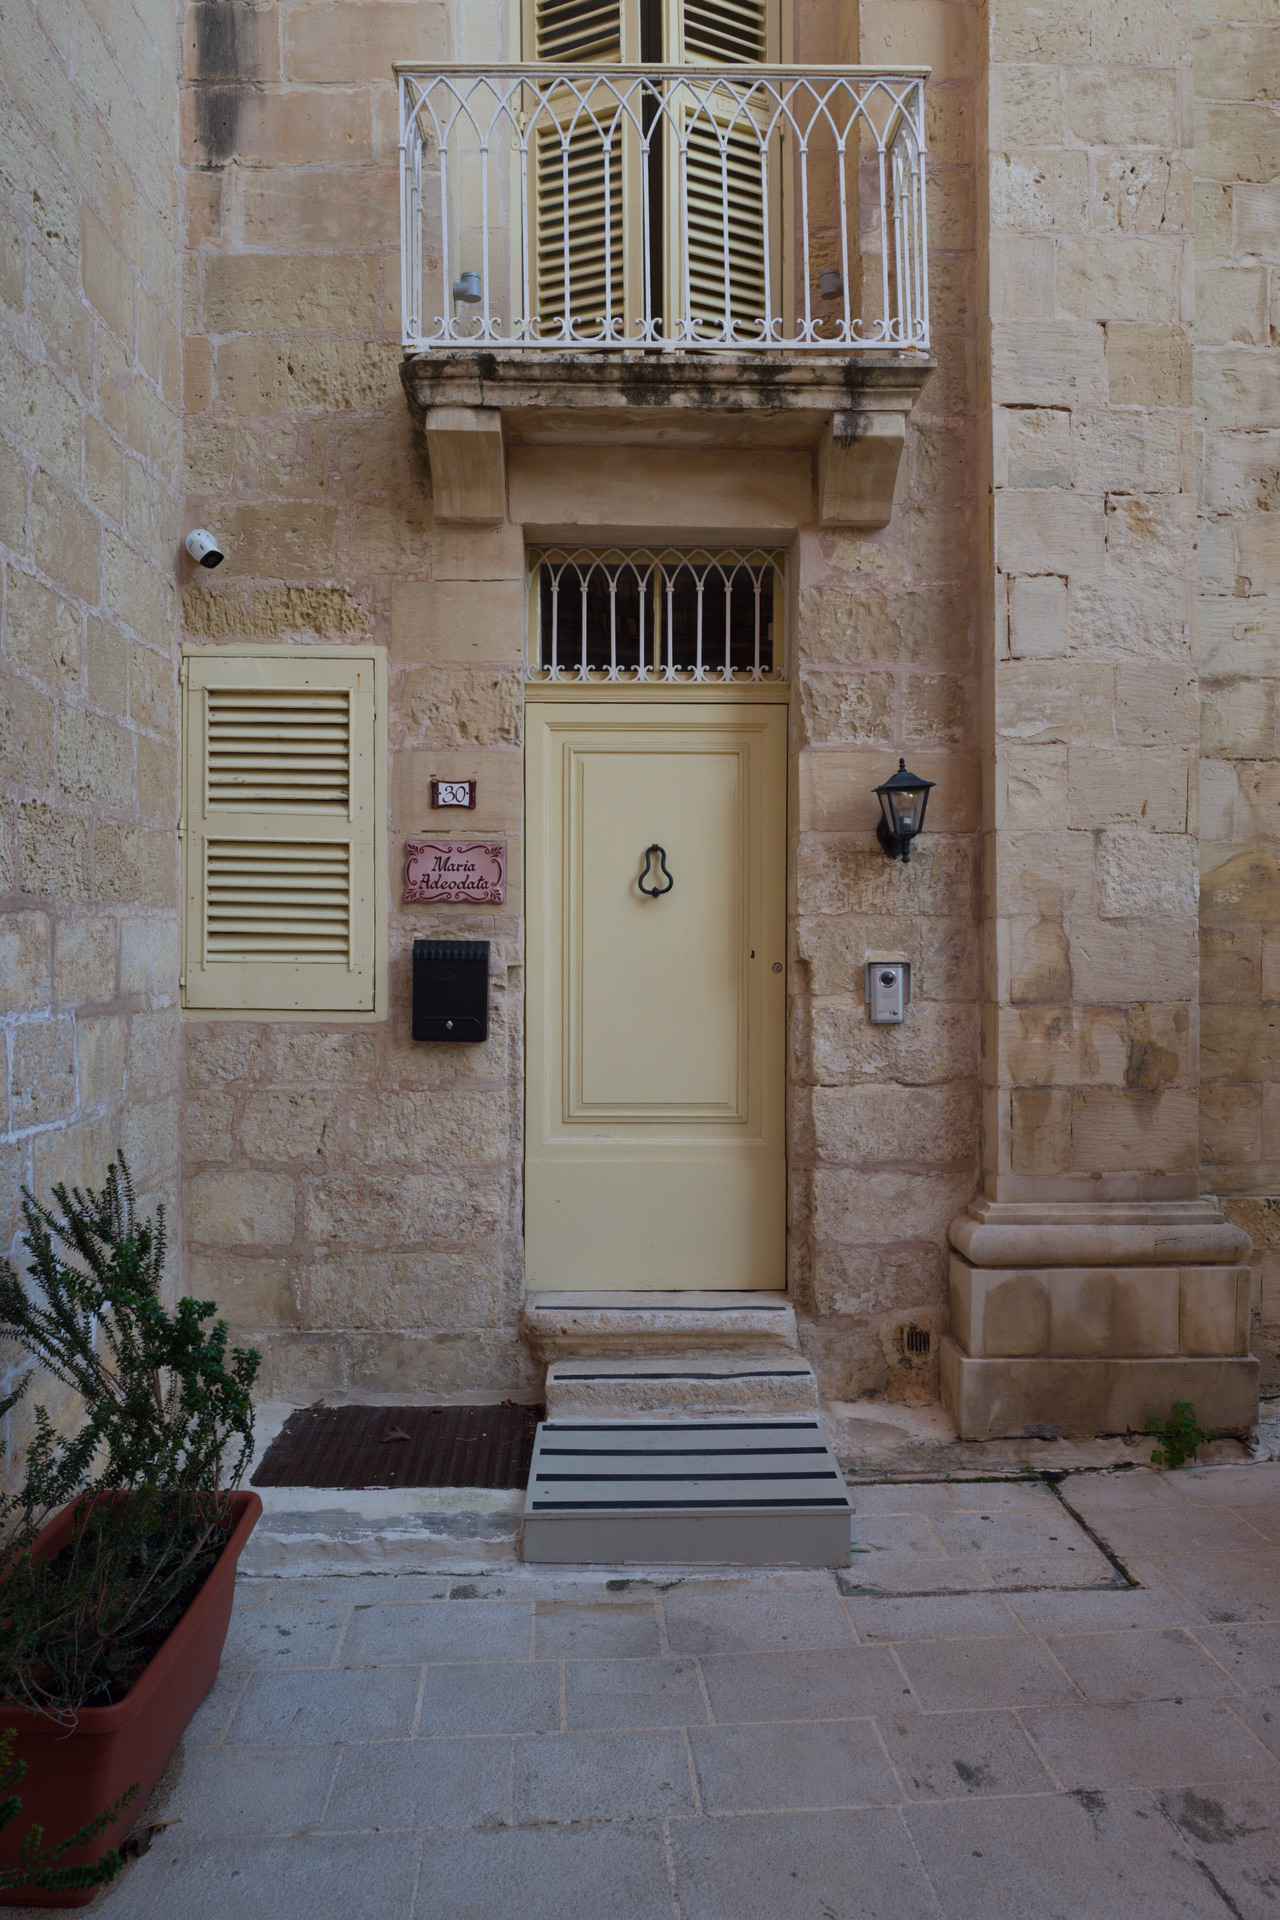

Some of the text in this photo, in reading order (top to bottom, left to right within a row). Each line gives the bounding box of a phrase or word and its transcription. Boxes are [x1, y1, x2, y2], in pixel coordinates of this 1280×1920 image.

[442, 785, 466, 803] 30
[432, 856, 476, 872] Maria
[418, 874, 489, 890] Adeodata
